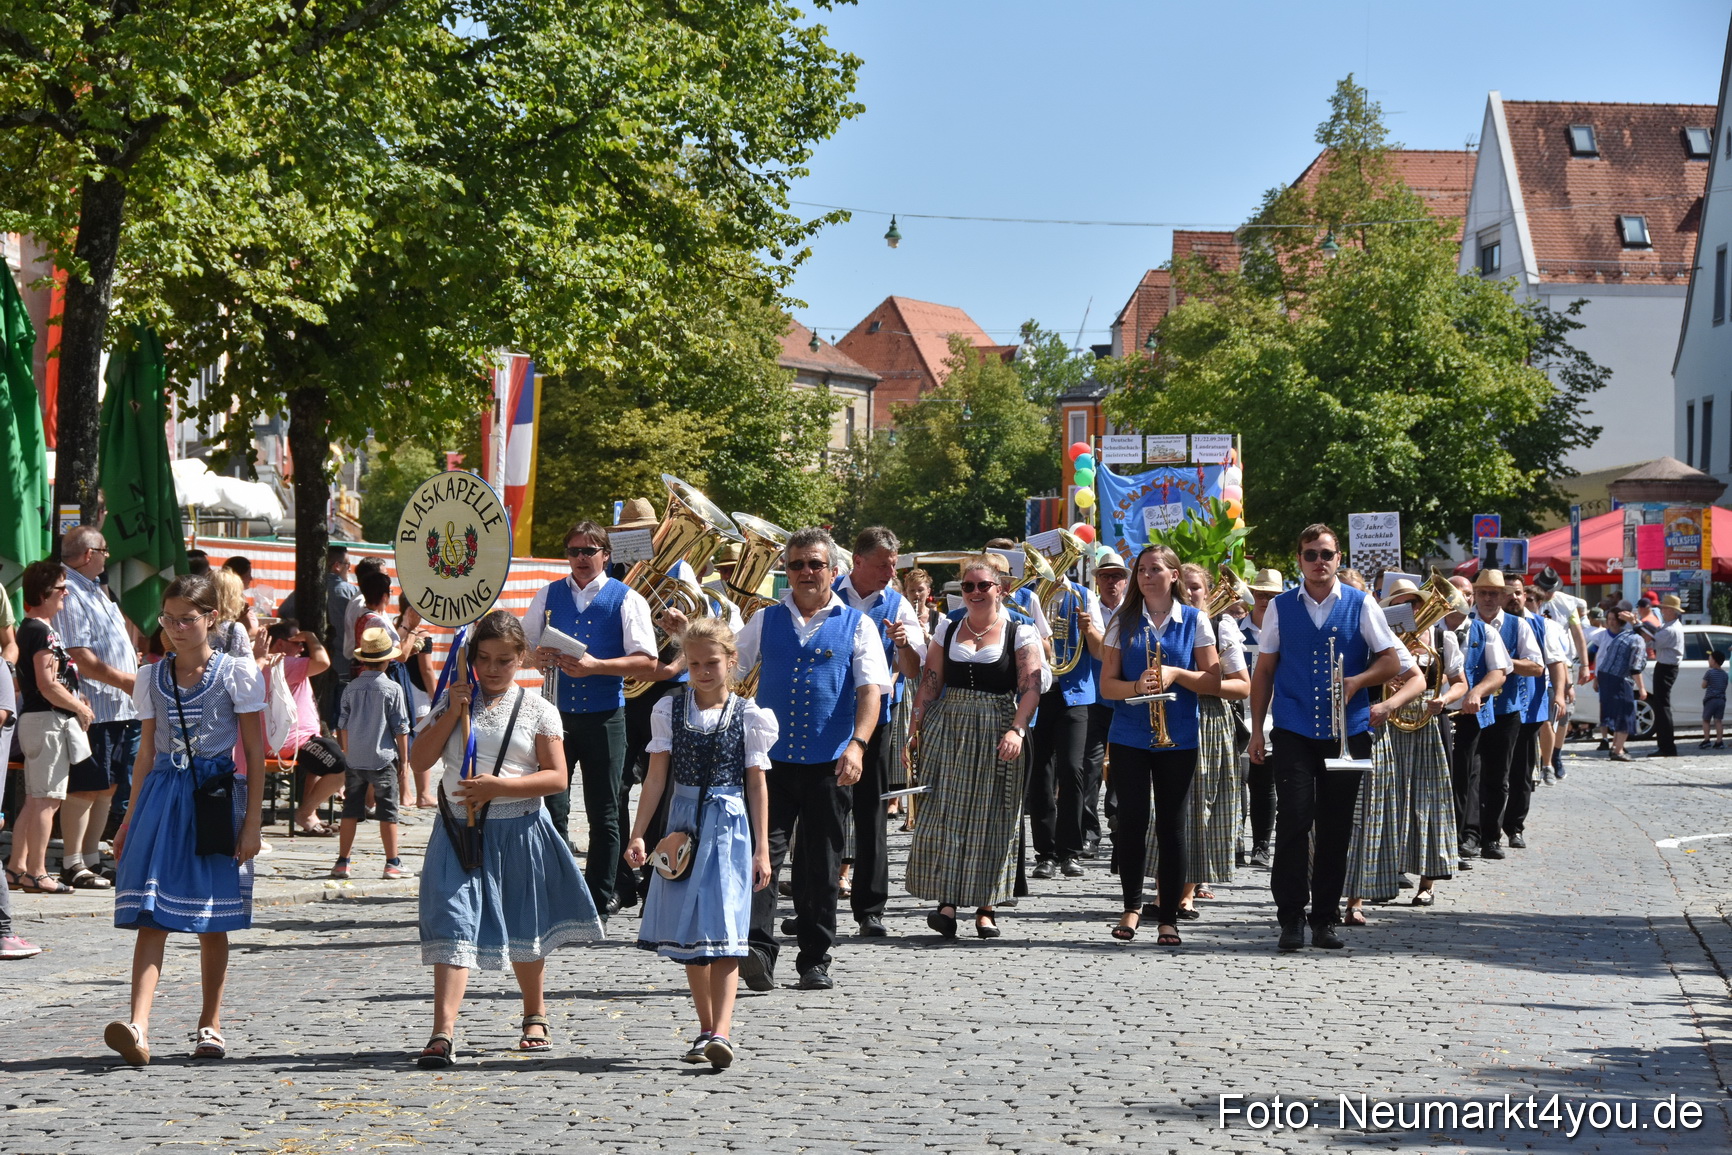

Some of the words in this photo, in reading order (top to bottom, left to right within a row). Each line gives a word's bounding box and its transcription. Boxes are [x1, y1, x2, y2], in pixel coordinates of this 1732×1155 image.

[400, 477, 503, 544] BLASKAPELLE
[1355, 532, 1394, 540] Schachklub
[1666, 535, 1701, 547] VOLKSFEST
[1606, 557, 1623, 573] Glo
[416, 579, 492, 621] DEINING
